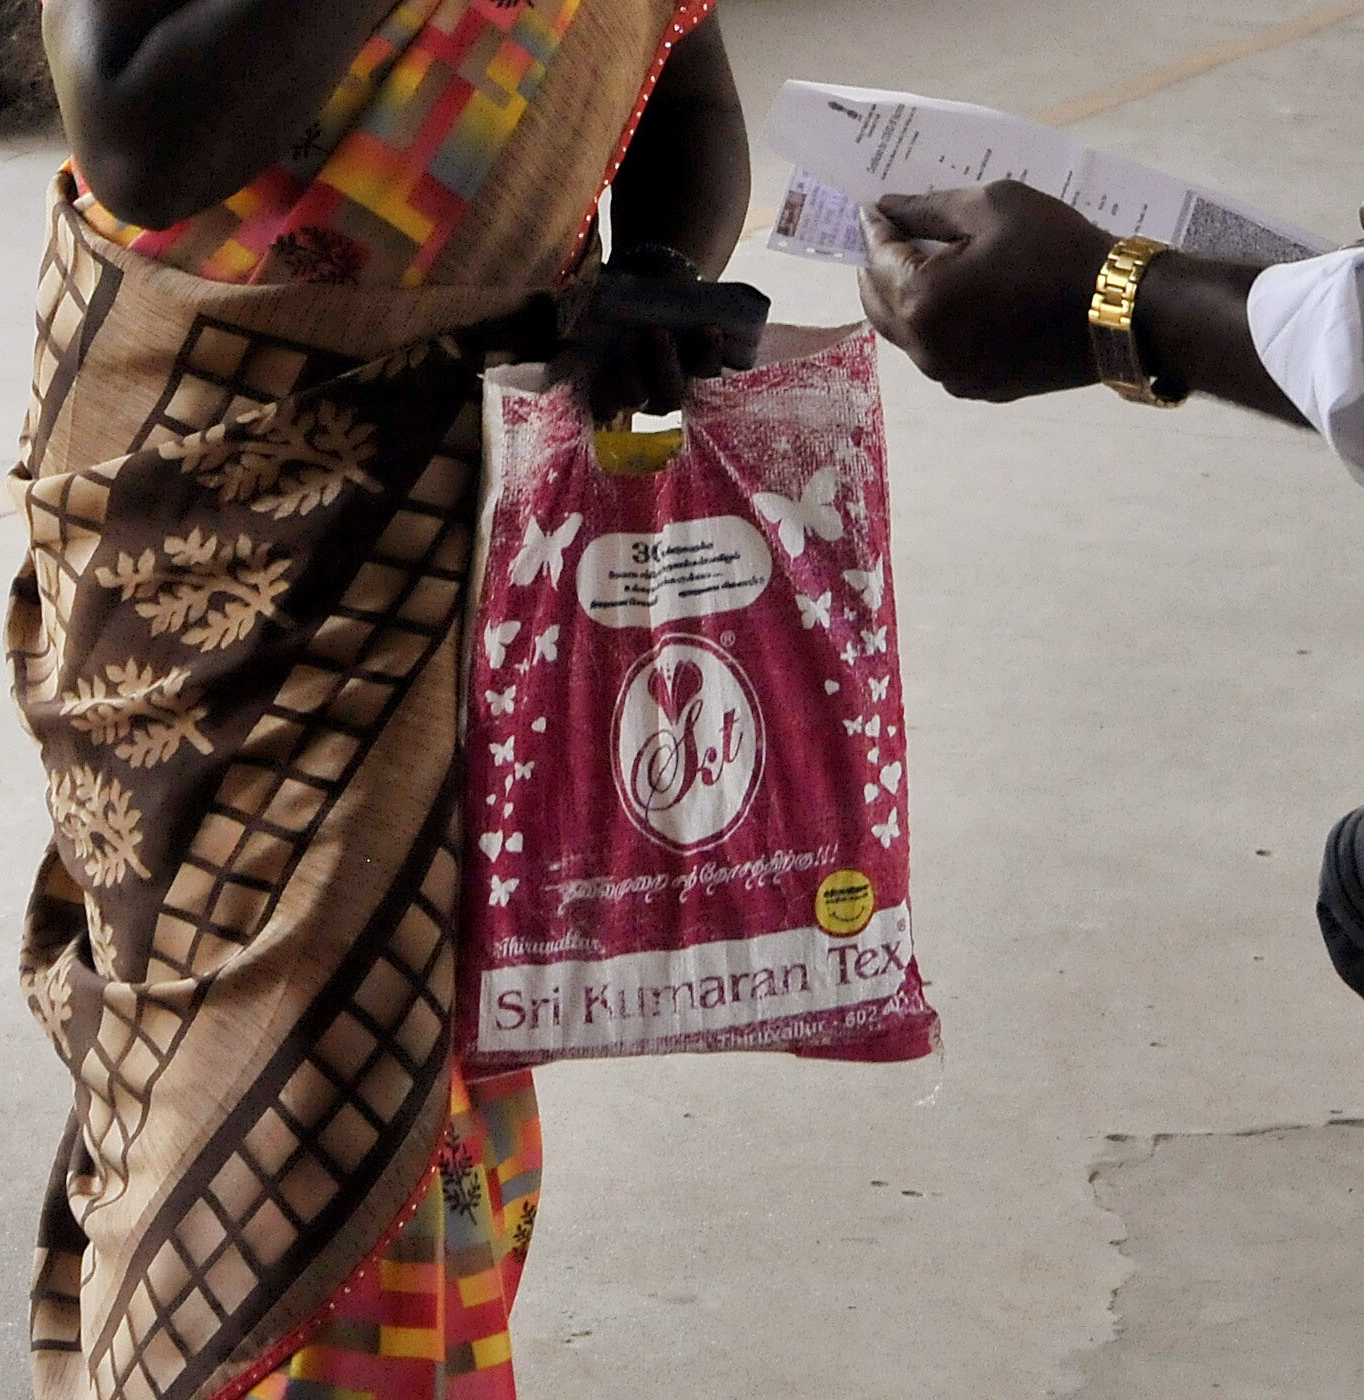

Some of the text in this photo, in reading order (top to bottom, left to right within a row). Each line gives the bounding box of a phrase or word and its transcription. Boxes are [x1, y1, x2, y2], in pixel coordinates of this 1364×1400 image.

[494, 939, 907, 1031] Sri Kumaran Tex
